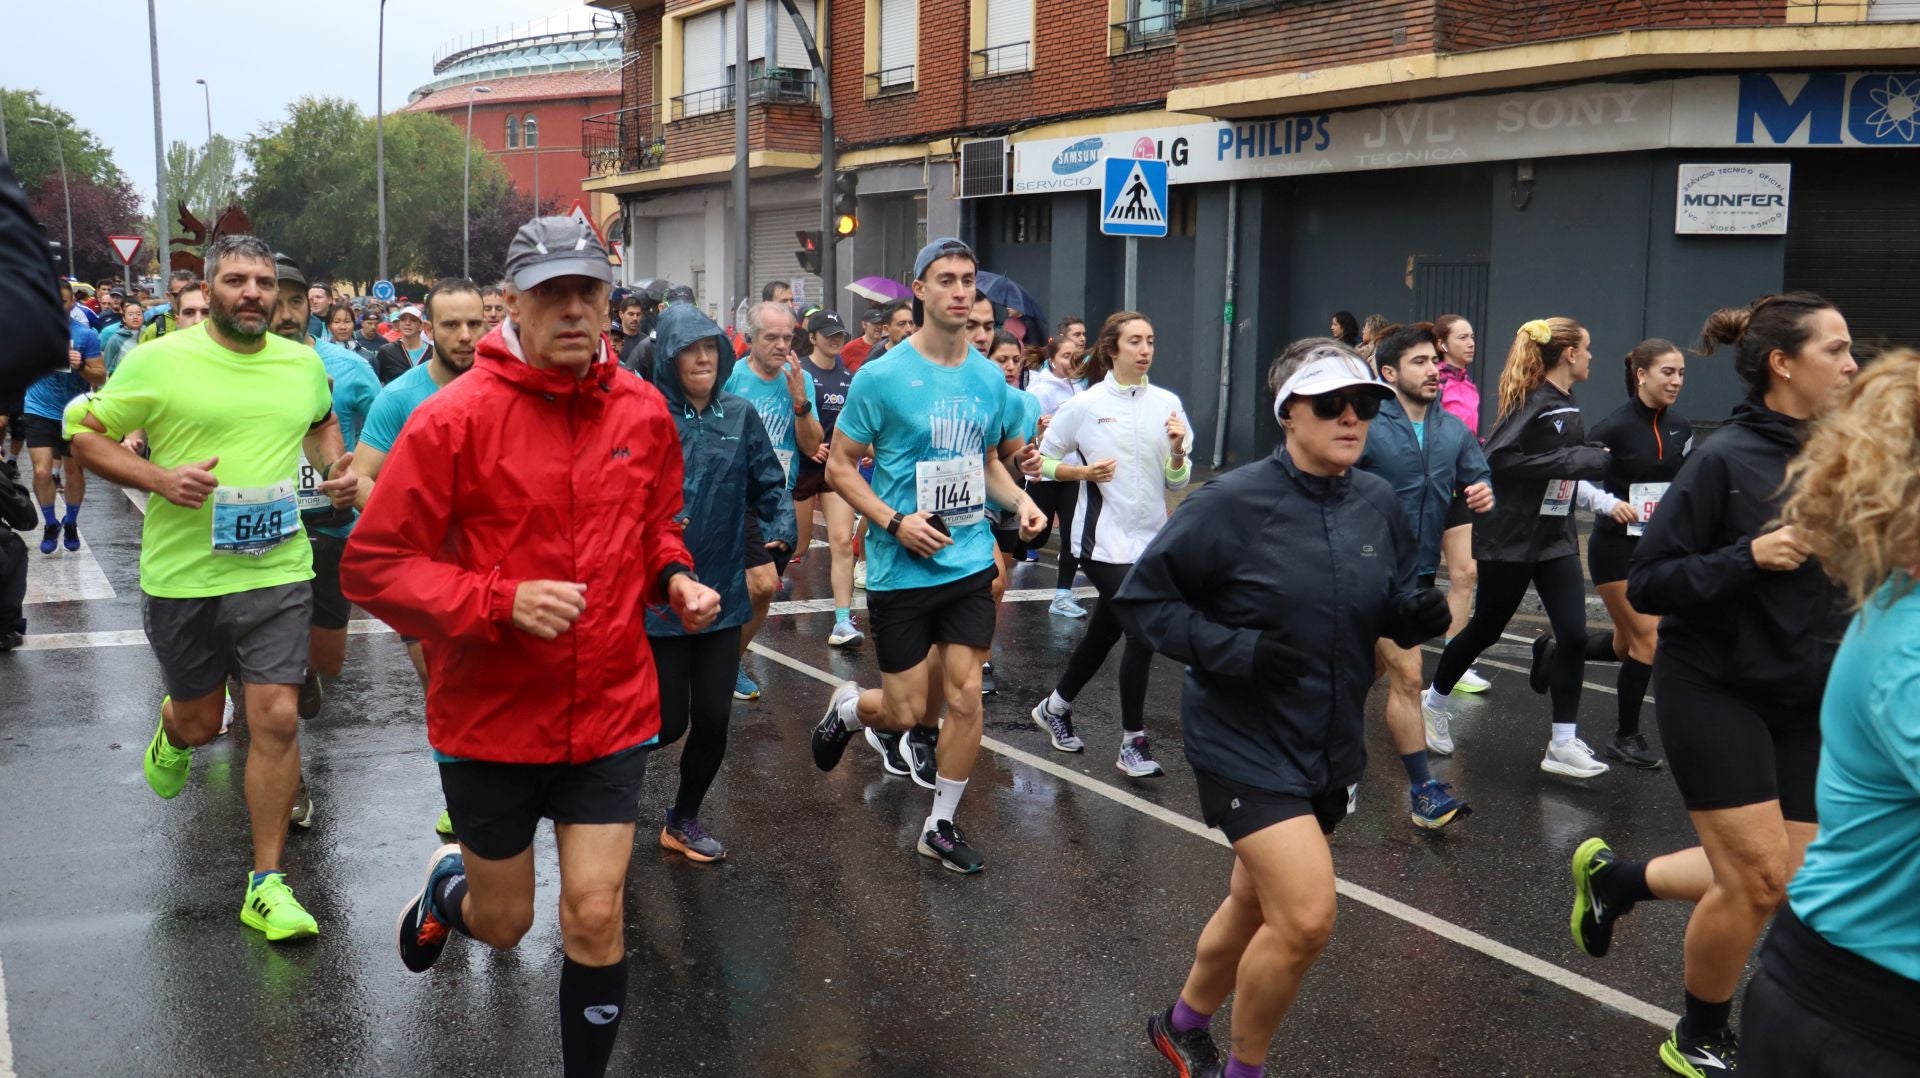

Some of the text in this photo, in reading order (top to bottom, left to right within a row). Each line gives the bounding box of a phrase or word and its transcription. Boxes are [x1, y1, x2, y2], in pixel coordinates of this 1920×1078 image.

[1497, 89, 1647, 133] SONY
[1217, 113, 1331, 162] PHILIPS
[1364, 103, 1456, 148] JVC
[1016, 176, 1092, 191] SERVICIO
[1355, 148, 1468, 168] TECNICA
[1058, 149, 1100, 165] SAMSUN
[1718, 167, 1754, 176] TECNICO
[1758, 172, 1785, 193] OFICIAL
[1683, 194, 1785, 207] MONFER
[1709, 224, 1736, 233] VIDEO
[1750, 212, 1782, 231] SONIDO
[935, 482, 971, 510] 1144
[236, 511, 282, 540] 649
